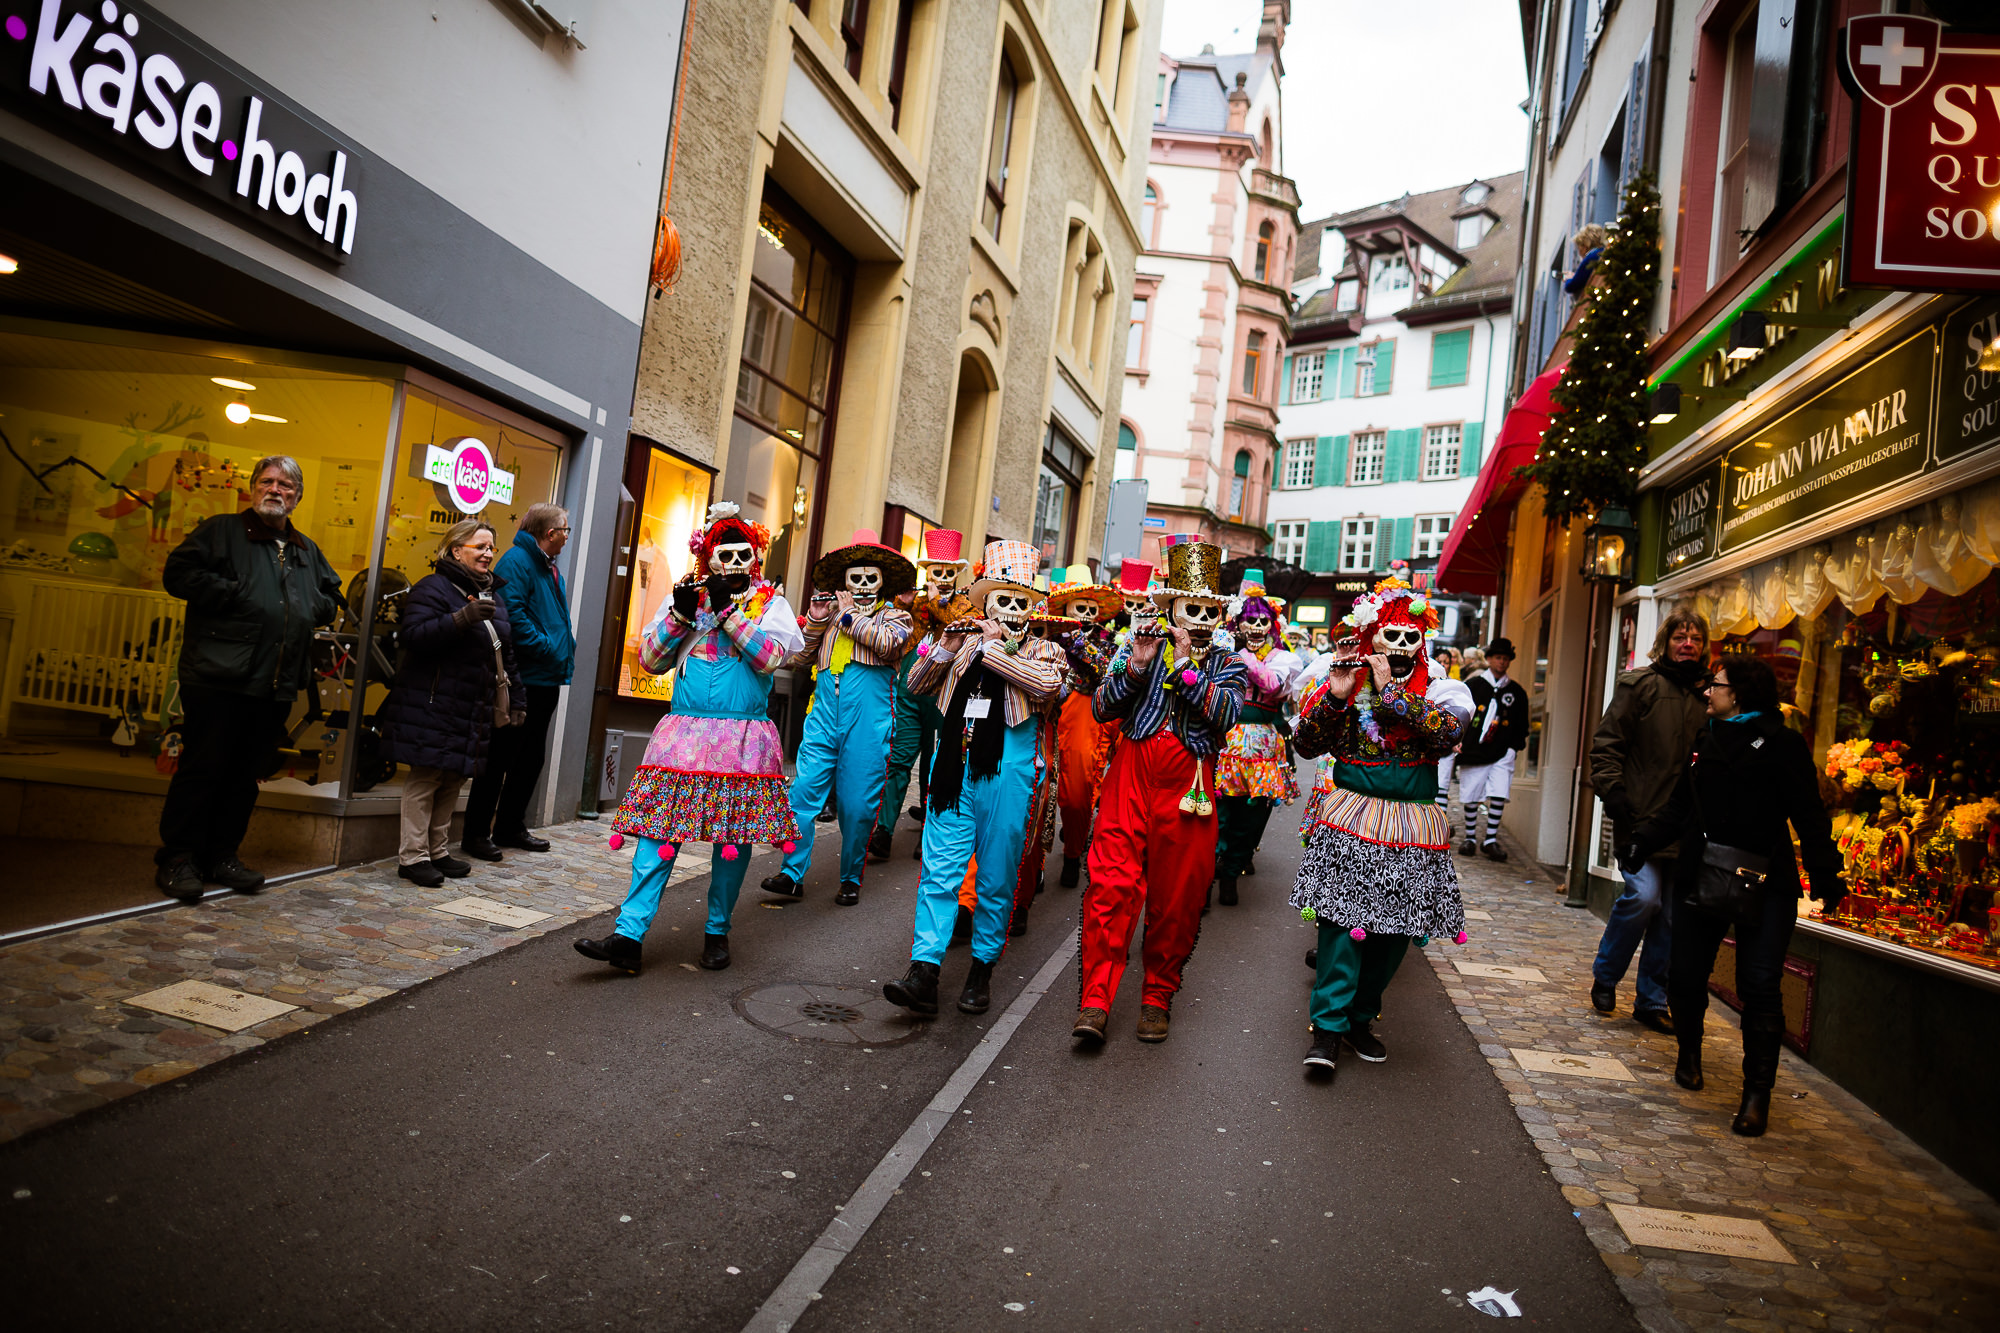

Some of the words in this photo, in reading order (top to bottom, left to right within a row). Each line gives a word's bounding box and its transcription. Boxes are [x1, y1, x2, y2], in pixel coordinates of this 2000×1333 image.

[1732, 440, 1806, 507] JOHANN
[1809, 388, 1908, 467] WANNER
[431, 454, 455, 481] drei
[455, 457, 487, 493] käse
[488, 471, 512, 502] hoch
[1669, 478, 1710, 526] SWISS
[1667, 511, 1707, 547] QUALITY
[630, 676, 672, 697] DOSSIER
[1639, 1222, 1694, 1234] JOHANN
[1699, 1229, 1760, 1242] WANNER
